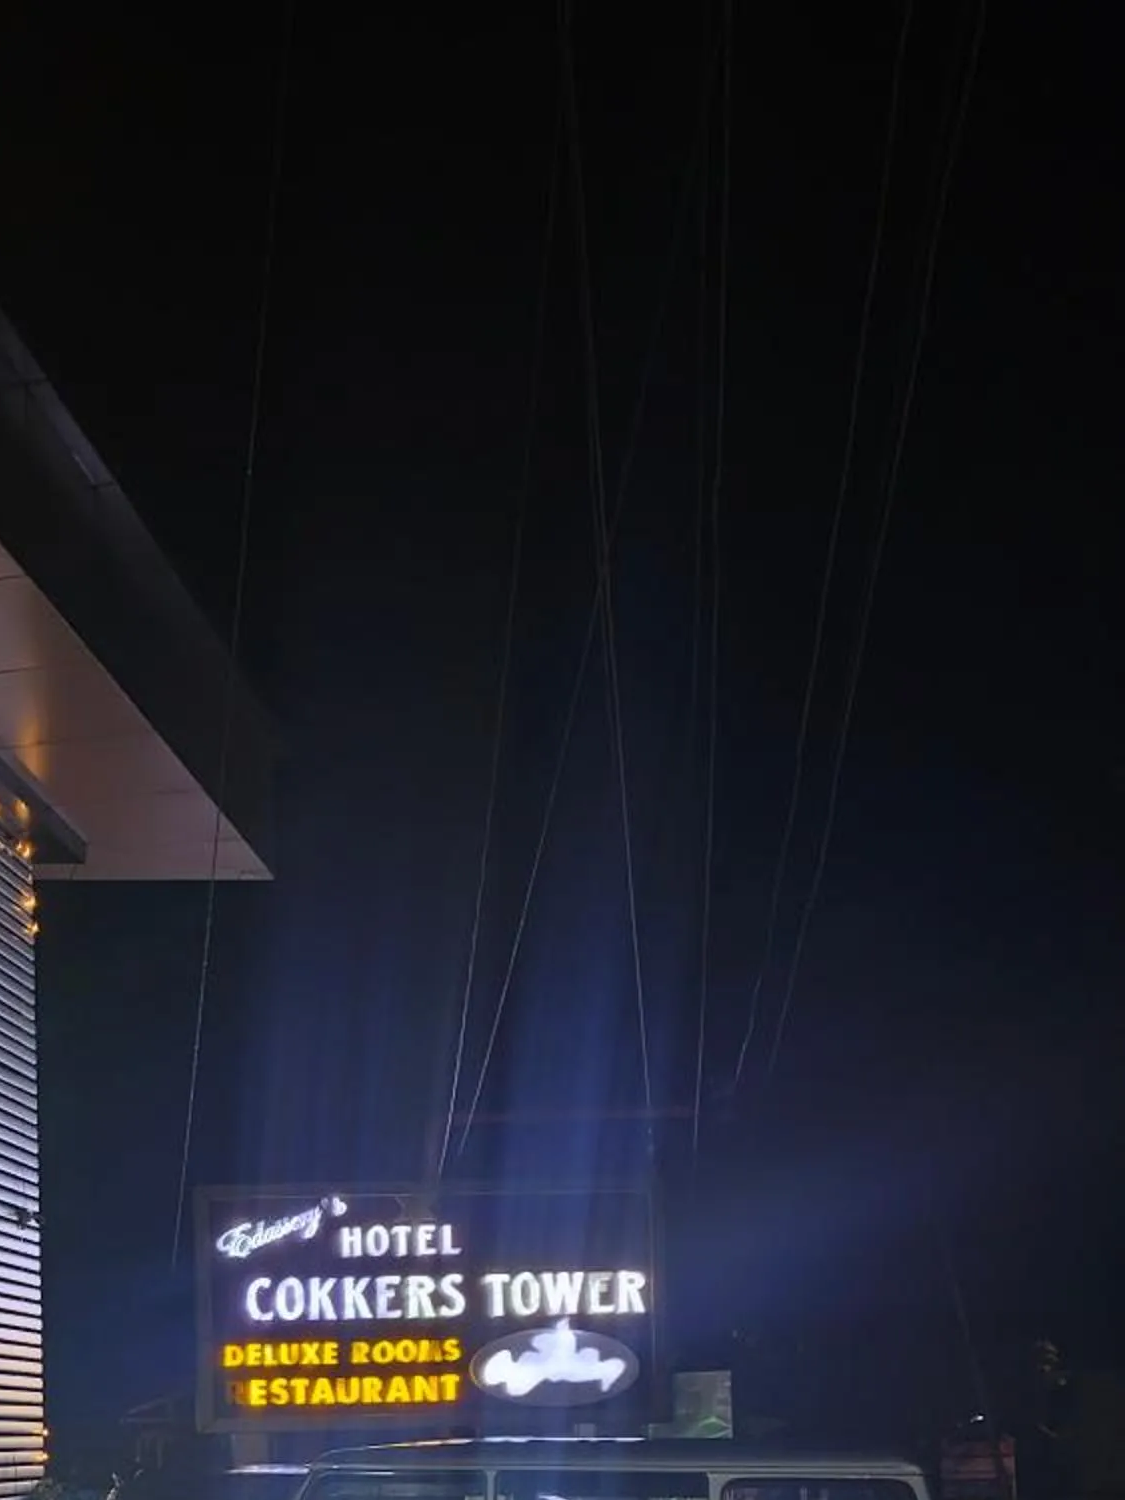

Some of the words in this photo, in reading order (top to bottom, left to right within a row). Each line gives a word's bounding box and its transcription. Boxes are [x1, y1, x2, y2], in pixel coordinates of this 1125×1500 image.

[340, 1224, 462, 1258] HOTEL
[245, 1272, 466, 1322] COKKERS
[481, 1269, 648, 1318] TOWER
[223, 1341, 340, 1368] DELUXE
[351, 1338, 462, 1365] ROOMS
